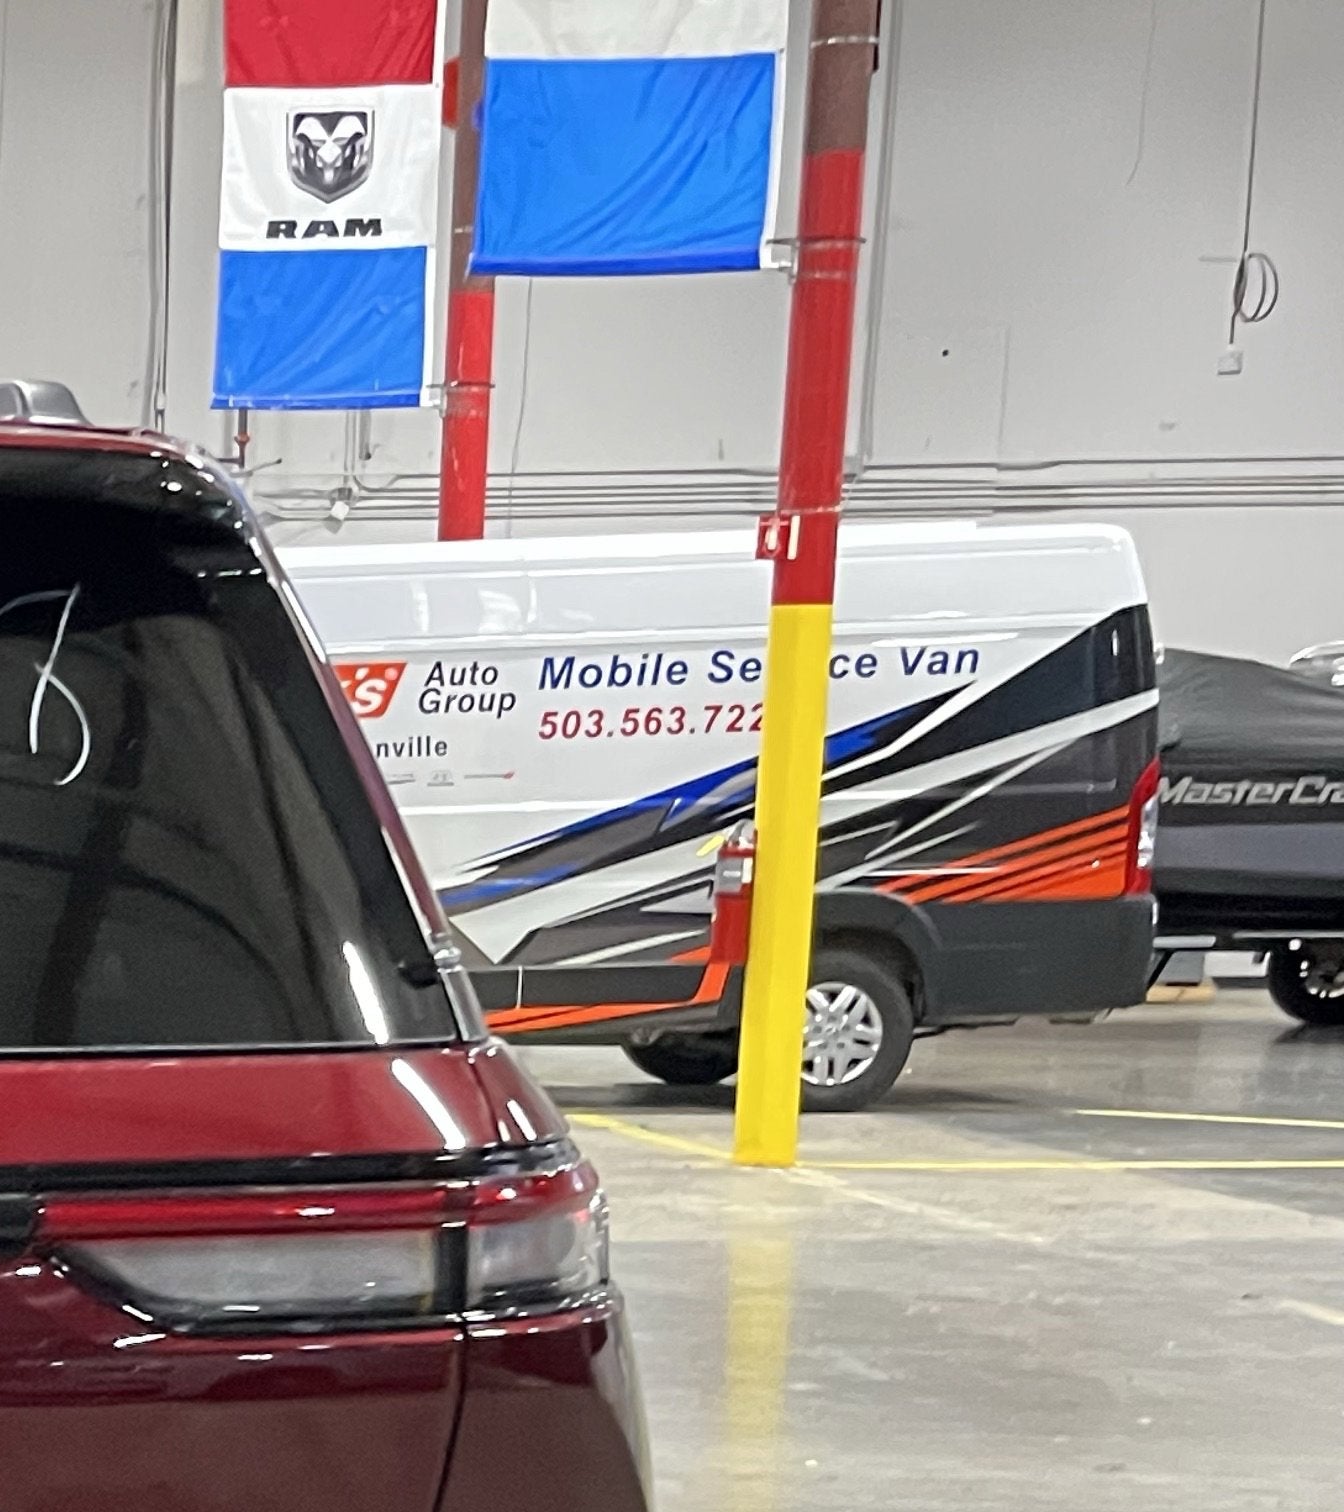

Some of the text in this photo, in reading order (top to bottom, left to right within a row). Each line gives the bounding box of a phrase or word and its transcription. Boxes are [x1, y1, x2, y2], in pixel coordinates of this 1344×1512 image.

[265, 217, 384, 240] RAM
[424, 661, 499, 688] Auto
[537, 645, 980, 691] Mobile Sece Van
[418, 687, 517, 719] Group
[538, 701, 764, 741] 503.563.722
[375, 735, 448, 758] nville
